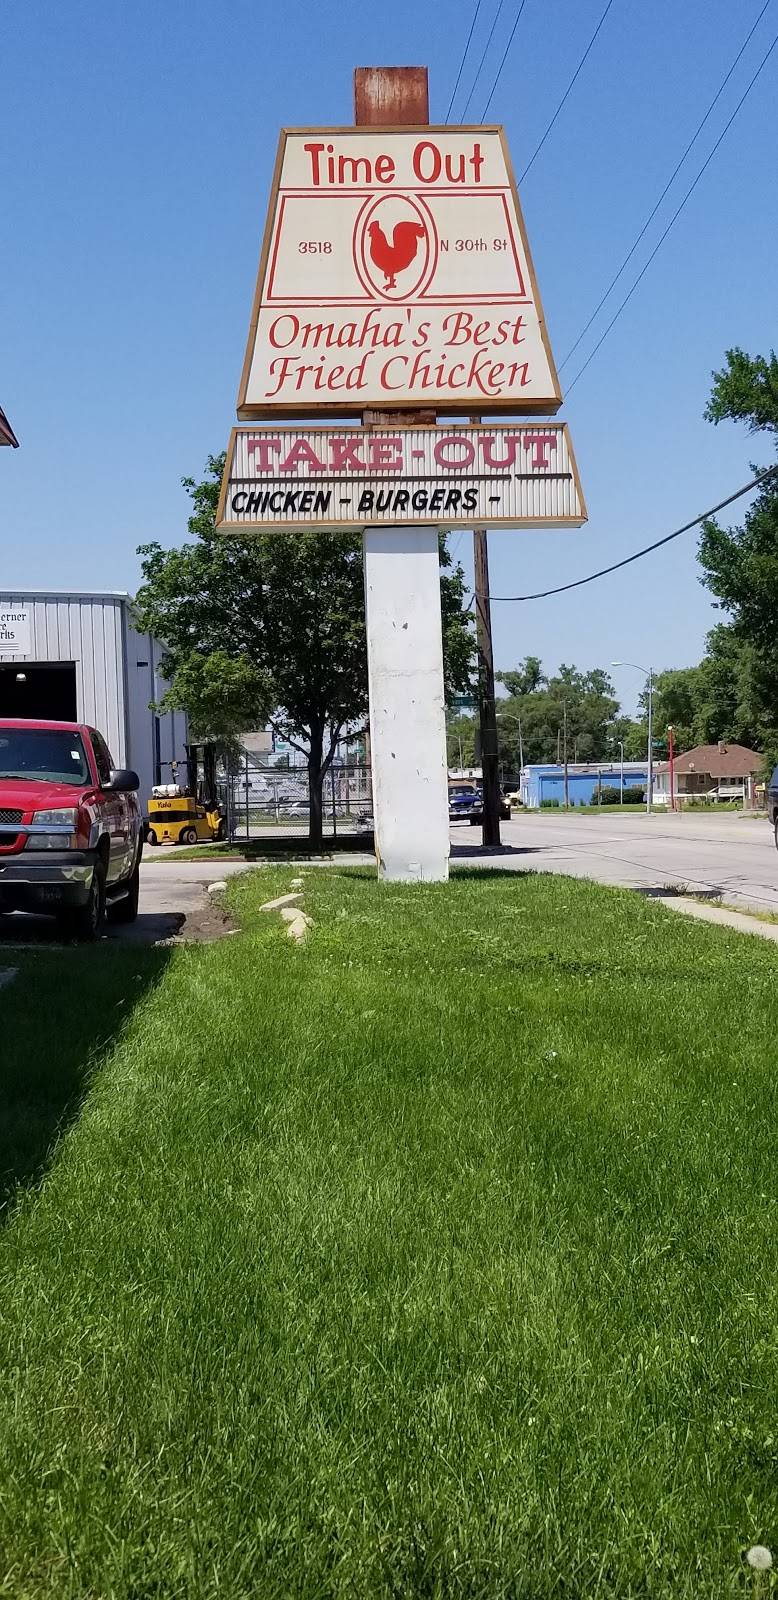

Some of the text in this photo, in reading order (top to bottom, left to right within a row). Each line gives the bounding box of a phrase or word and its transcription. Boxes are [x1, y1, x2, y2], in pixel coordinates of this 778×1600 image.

[303, 141, 485, 186] Time Out
[298, 241, 333, 255] 3518
[439, 238, 508, 252] N 30th St
[268, 307, 527, 349] Omaha's Best
[265, 348, 532, 397] Fried Chicken
[231, 490, 332, 514] CHICKEN
[357, 488, 479, 513] BURGERS
